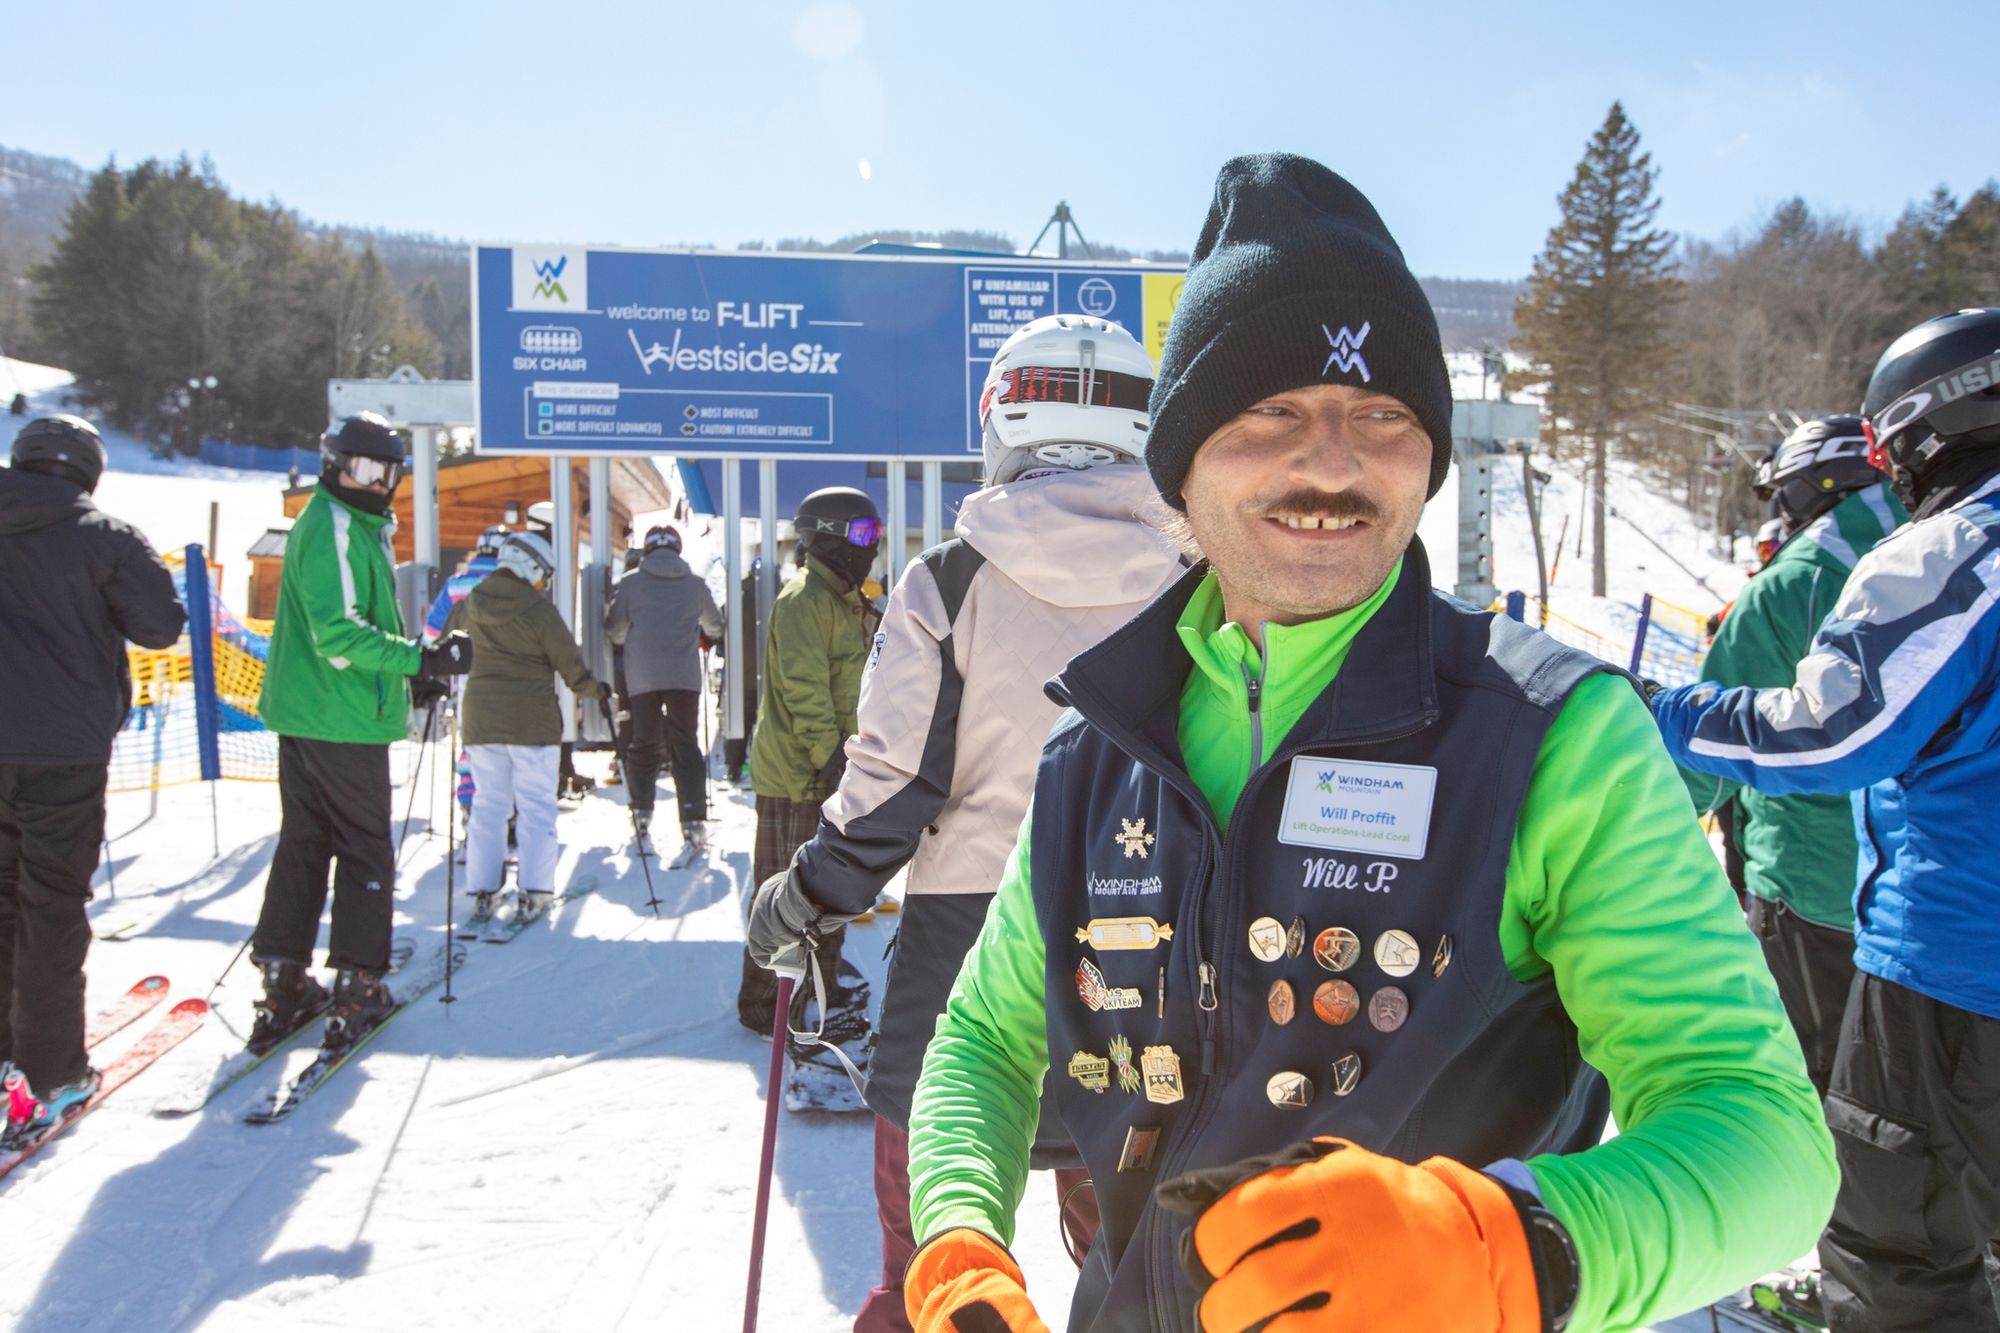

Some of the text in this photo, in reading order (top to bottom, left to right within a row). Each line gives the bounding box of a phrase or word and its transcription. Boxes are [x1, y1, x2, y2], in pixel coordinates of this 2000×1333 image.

[972, 279, 1050, 293] IF UNFAMILIAR
[978, 294, 1044, 307] WITH USE OF
[607, 301, 804, 329] welcome to F-LIFT
[1013, 309, 1035, 320] ASK
[513, 357, 587, 371] SIX CHAIR
[555, 404, 616, 416] MORE DIFFICULT
[700, 407, 759, 419] MOST DIFFICULT
[554, 421, 662, 435] MORE DIFFICULT (ADVANCED)
[736, 425, 776, 436] EXTREMELY
[777, 425, 813, 437] DIFFICULT
[1338, 776, 1404, 790] WINDHAM
[1338, 785, 1381, 794] MOUNTAIN
[1320, 806, 1398, 826] Will Proffit
[1293, 822, 1307, 831] Lift
[1385, 832, 1411, 842] Coral
[1302, 857, 1399, 894] Will P.
[1094, 887, 1138, 896] MOUNTAIN
[1103, 997, 1140, 1009] SKI TEAM
